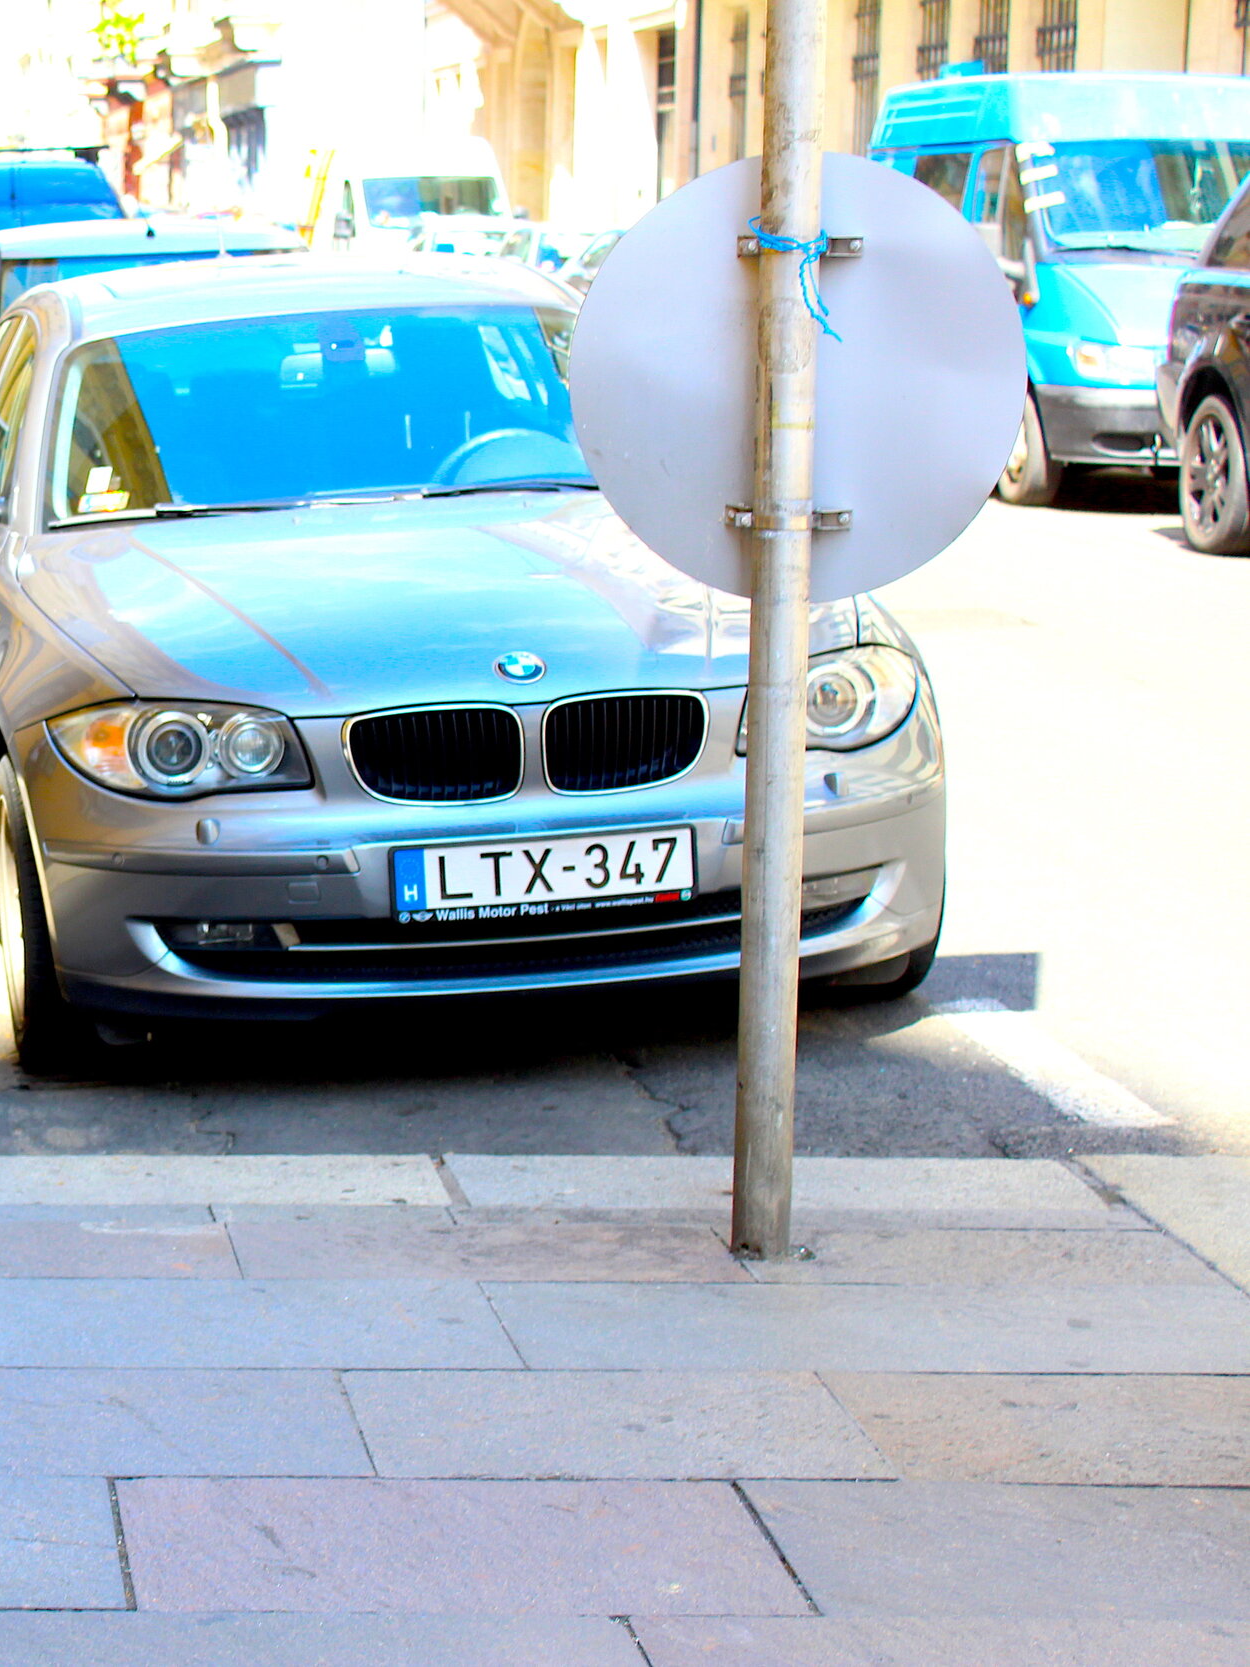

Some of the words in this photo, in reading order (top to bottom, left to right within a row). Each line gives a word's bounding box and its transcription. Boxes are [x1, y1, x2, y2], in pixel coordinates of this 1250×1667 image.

[438, 837, 677, 900] LTX-347
[403, 885, 419, 901] H
[435, 907, 476, 921] Wallis
[478, 904, 517, 919] Motor
[519, 903, 549, 916] Pest
